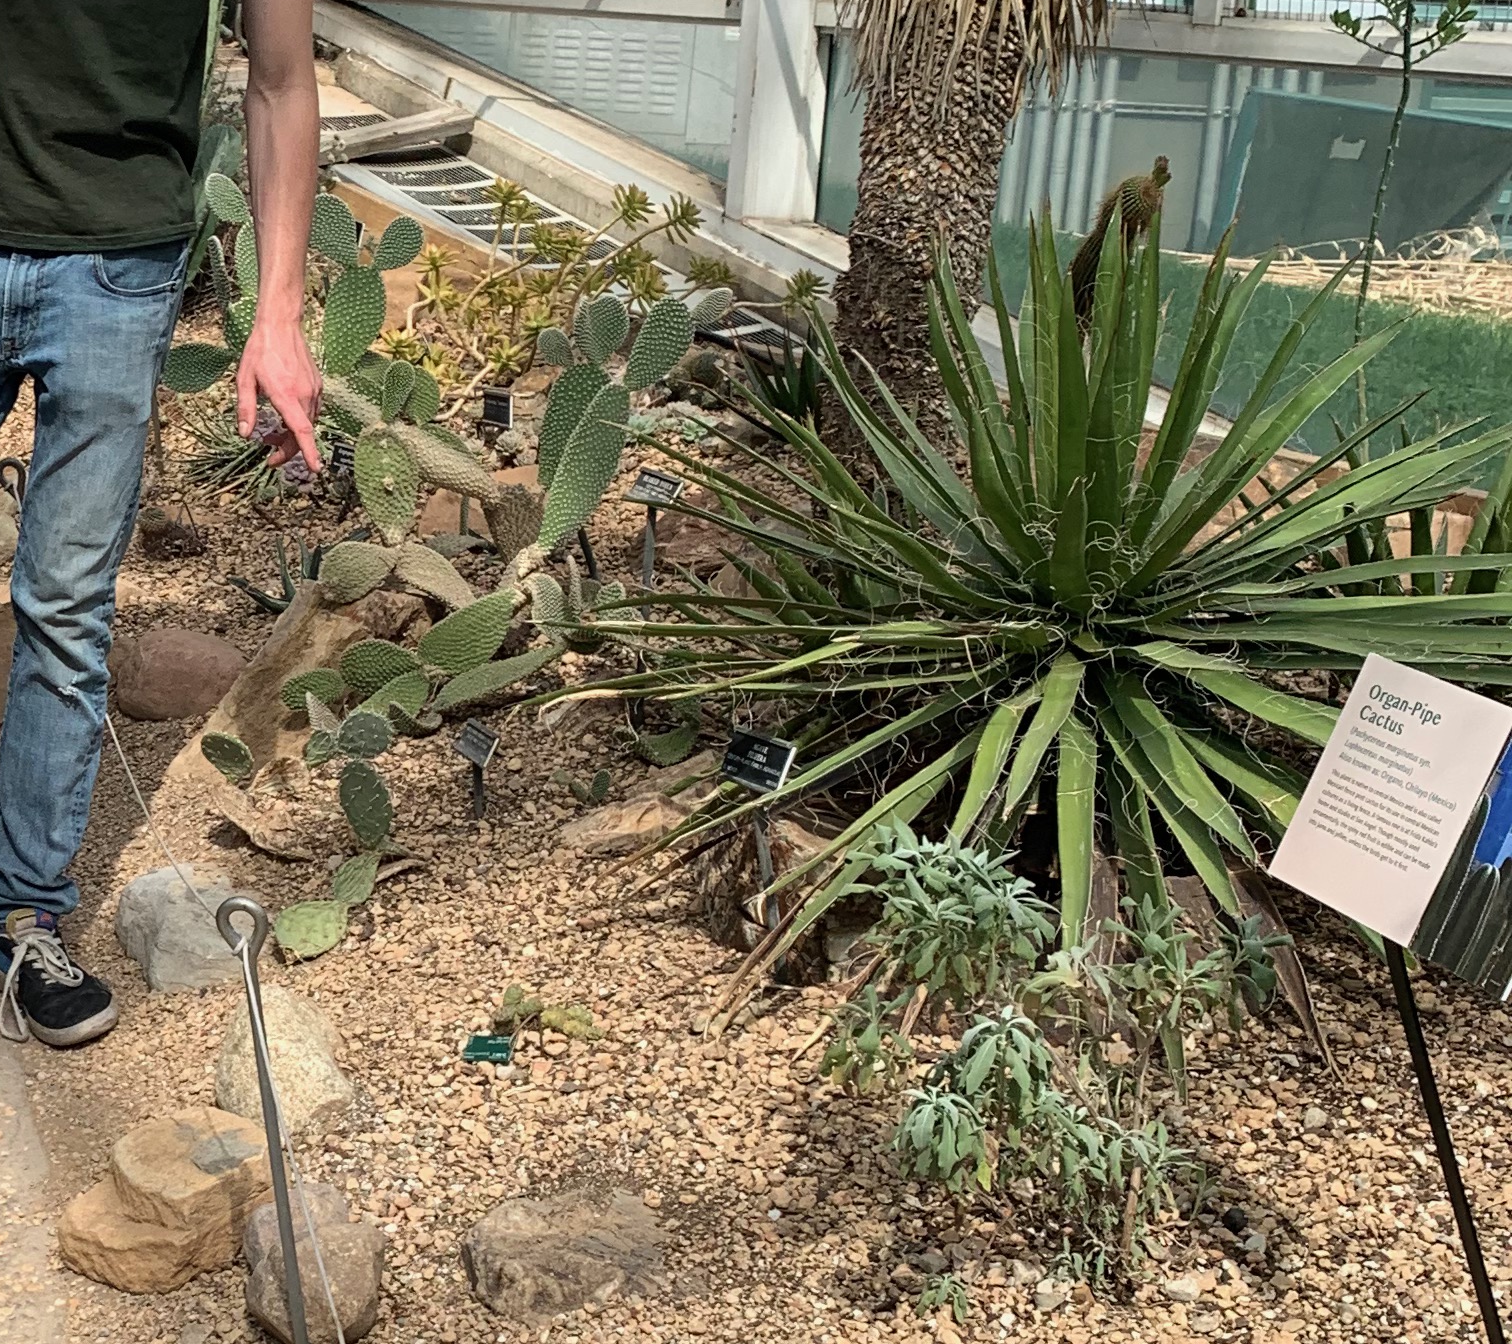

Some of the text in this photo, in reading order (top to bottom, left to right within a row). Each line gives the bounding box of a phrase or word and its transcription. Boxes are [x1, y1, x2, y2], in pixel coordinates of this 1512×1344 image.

[1359, 705, 1405, 736] Cactus
[1368, 684, 1442, 726] Organ-Pipe
[1427, 791, 1456, 811] (Mexico)
